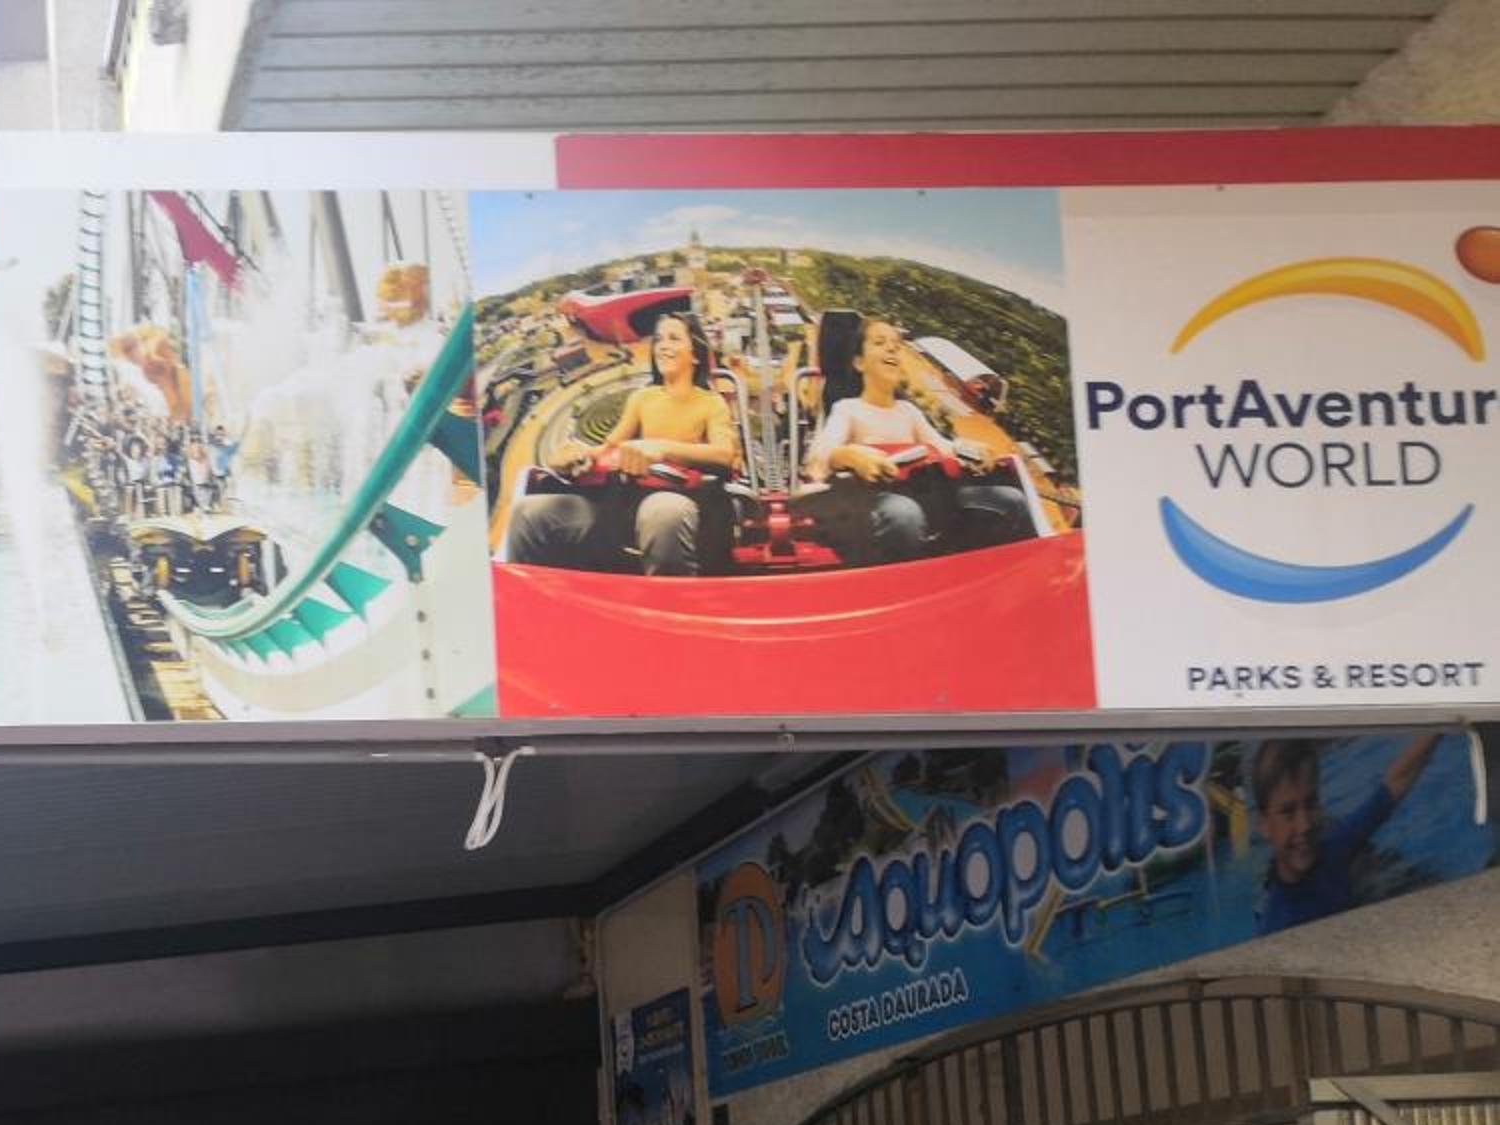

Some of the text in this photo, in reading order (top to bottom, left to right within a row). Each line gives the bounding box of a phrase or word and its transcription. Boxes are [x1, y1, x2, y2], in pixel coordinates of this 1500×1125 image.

[1196, 441, 1442, 488] WORLD
[1187, 662, 1484, 691] PARKS & RESORT
[827, 967, 970, 1041] COSTA DAURADA
